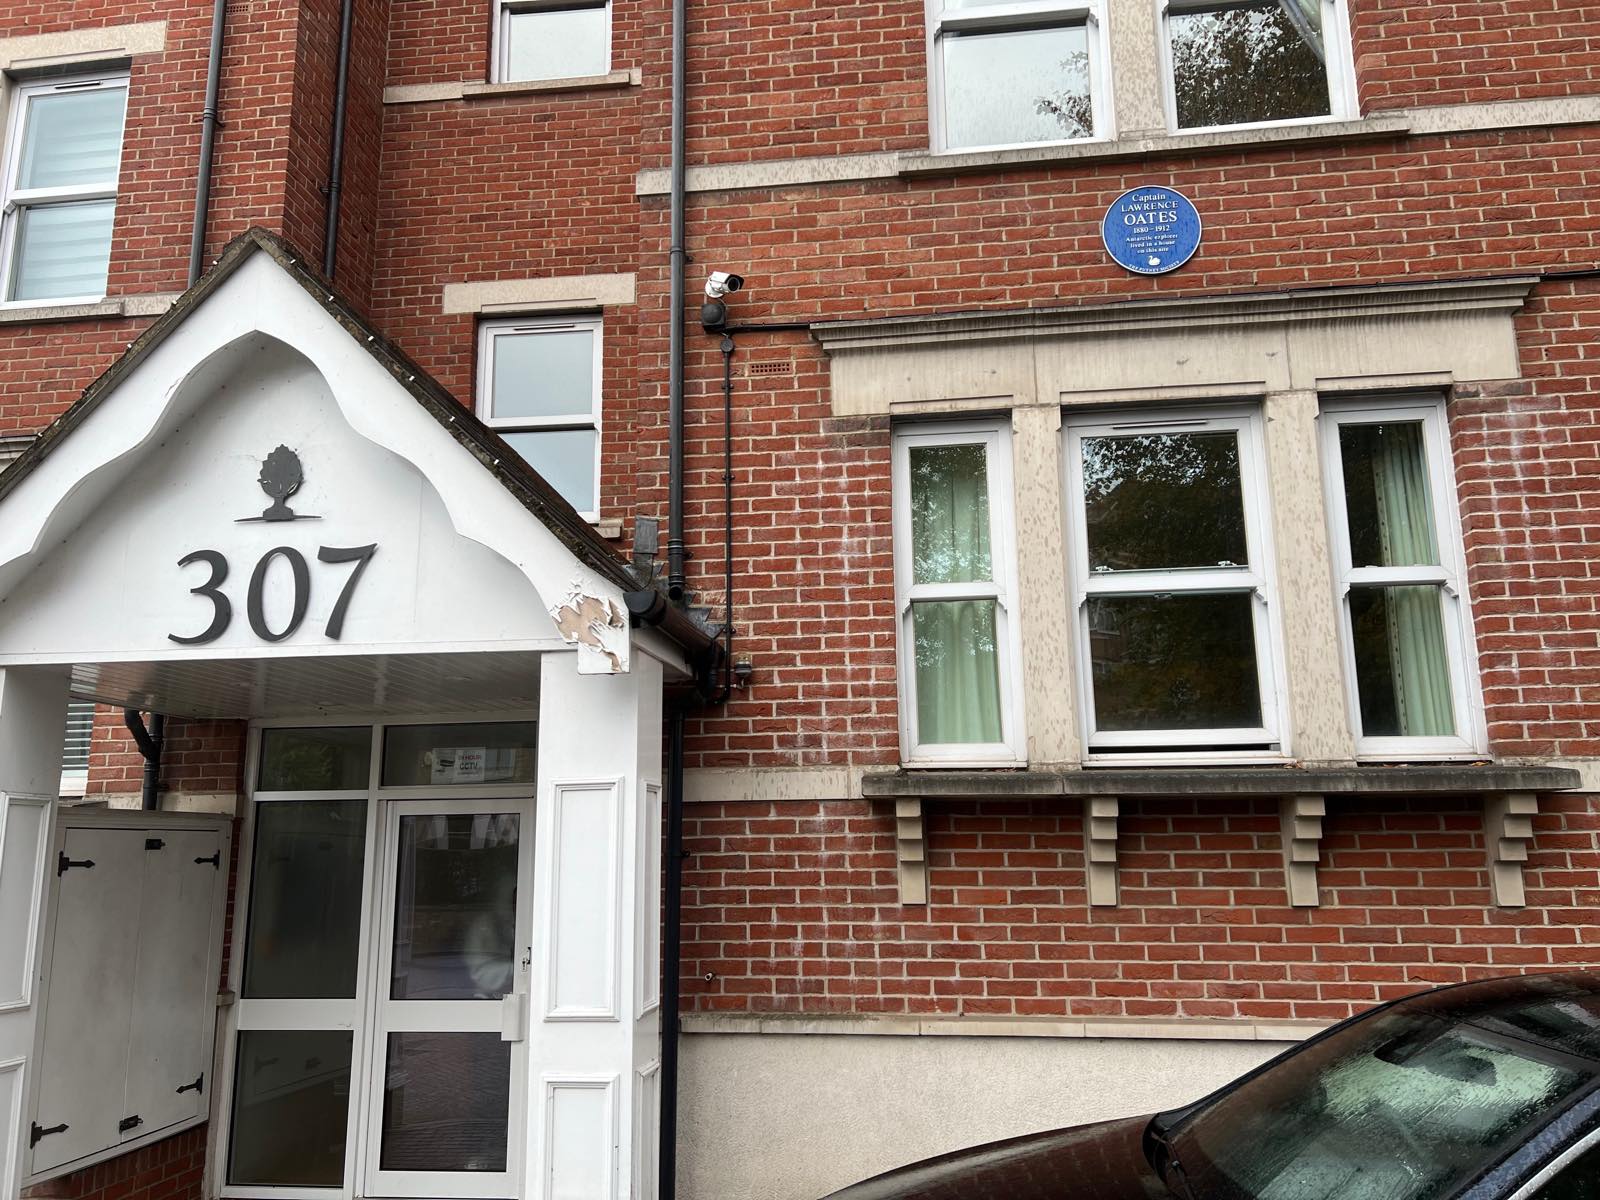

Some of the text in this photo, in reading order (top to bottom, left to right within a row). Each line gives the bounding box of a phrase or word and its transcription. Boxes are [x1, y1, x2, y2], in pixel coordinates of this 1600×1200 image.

[1132, 193, 1166, 202] Captain
[1121, 201, 1179, 212] LAWRENCE
[1124, 211, 1177, 225] OATES
[168, 543, 378, 645] 307
[460, 762, 478, 770] CCTV
